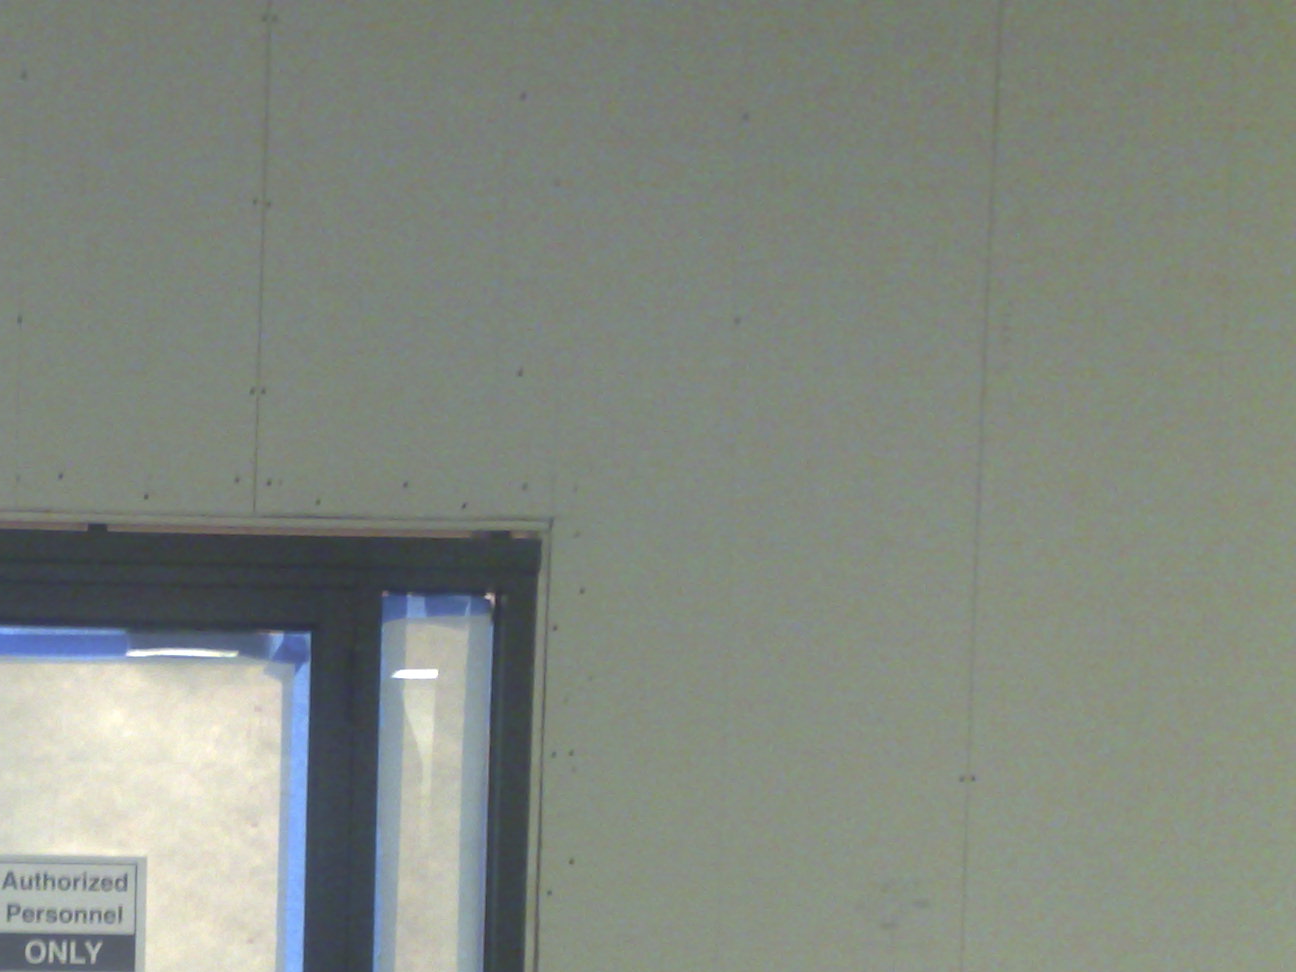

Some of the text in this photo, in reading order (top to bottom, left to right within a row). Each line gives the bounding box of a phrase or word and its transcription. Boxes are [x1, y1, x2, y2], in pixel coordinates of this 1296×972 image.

[1, 869, 129, 893] Authorized
[6, 903, 124, 925] Personnel
[24, 939, 103, 966] ONLY
